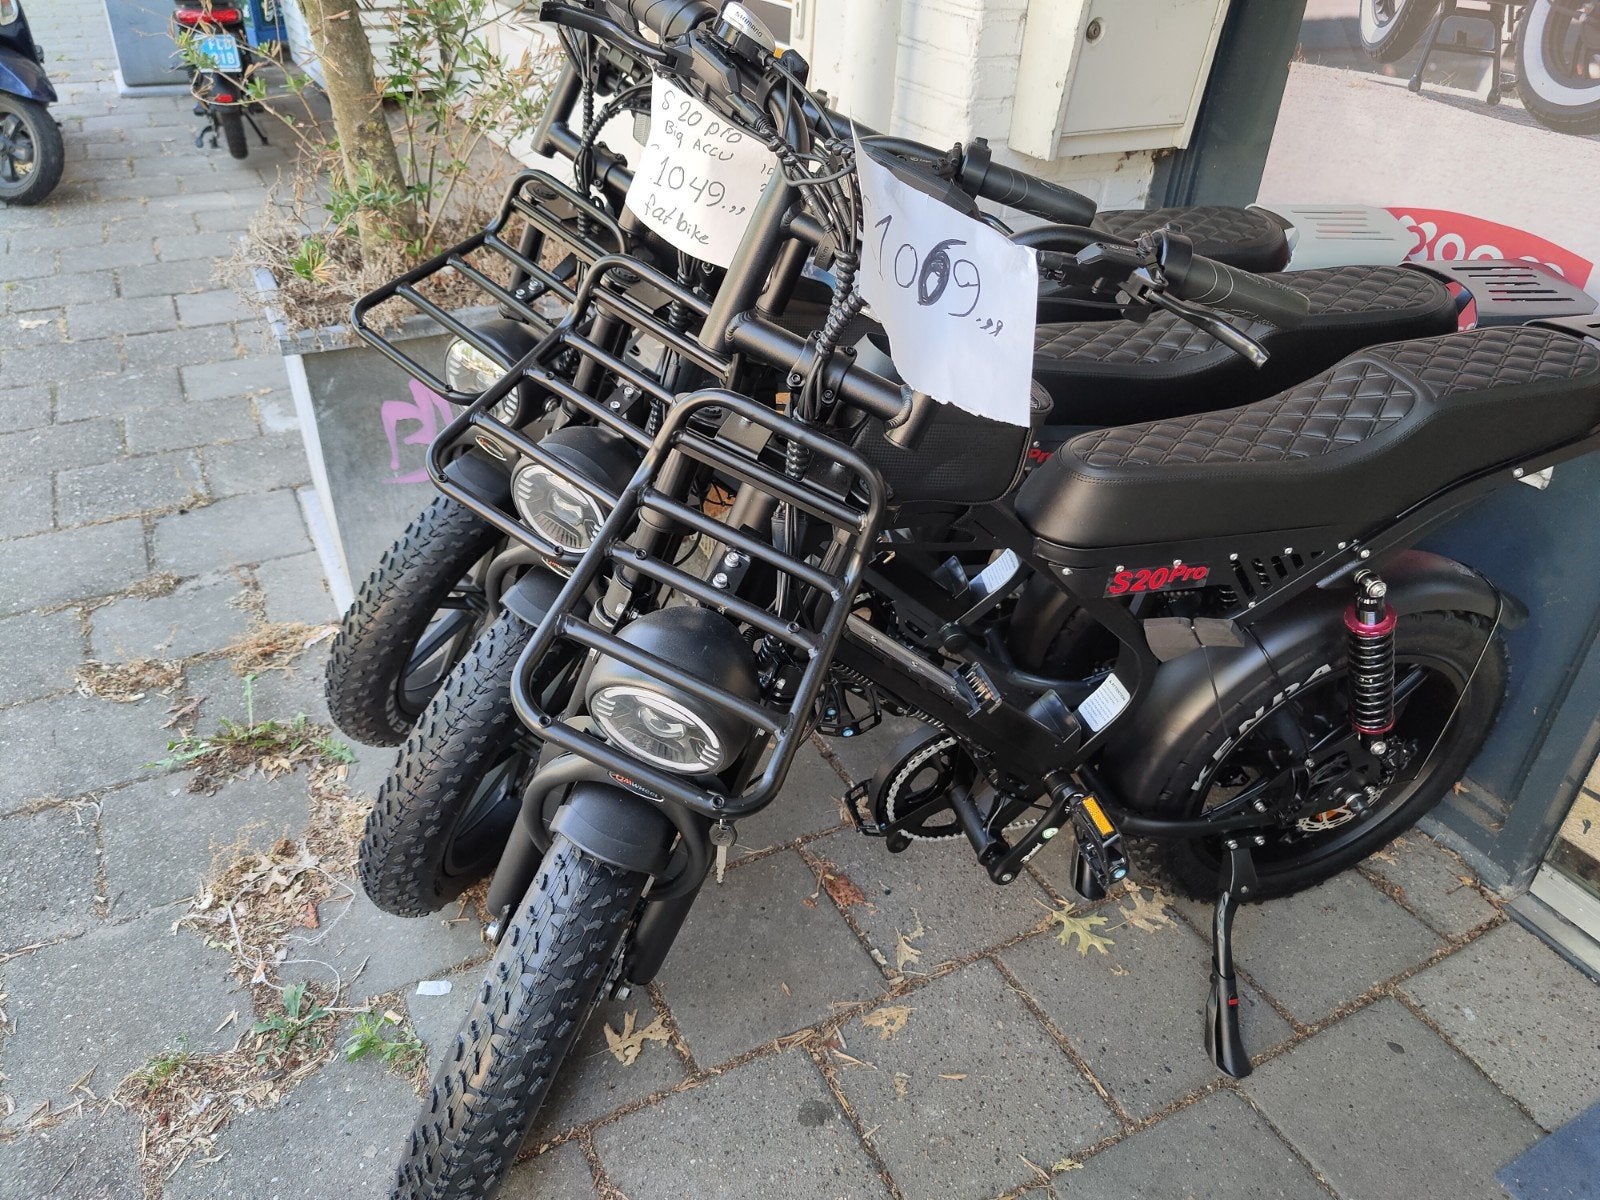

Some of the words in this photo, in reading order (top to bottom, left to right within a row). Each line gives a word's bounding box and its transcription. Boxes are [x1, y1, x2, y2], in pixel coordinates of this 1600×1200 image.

[735, 11, 763, 38] SHIMANO
[661, 90, 675, 110] S
[677, 101, 702, 126] 20
